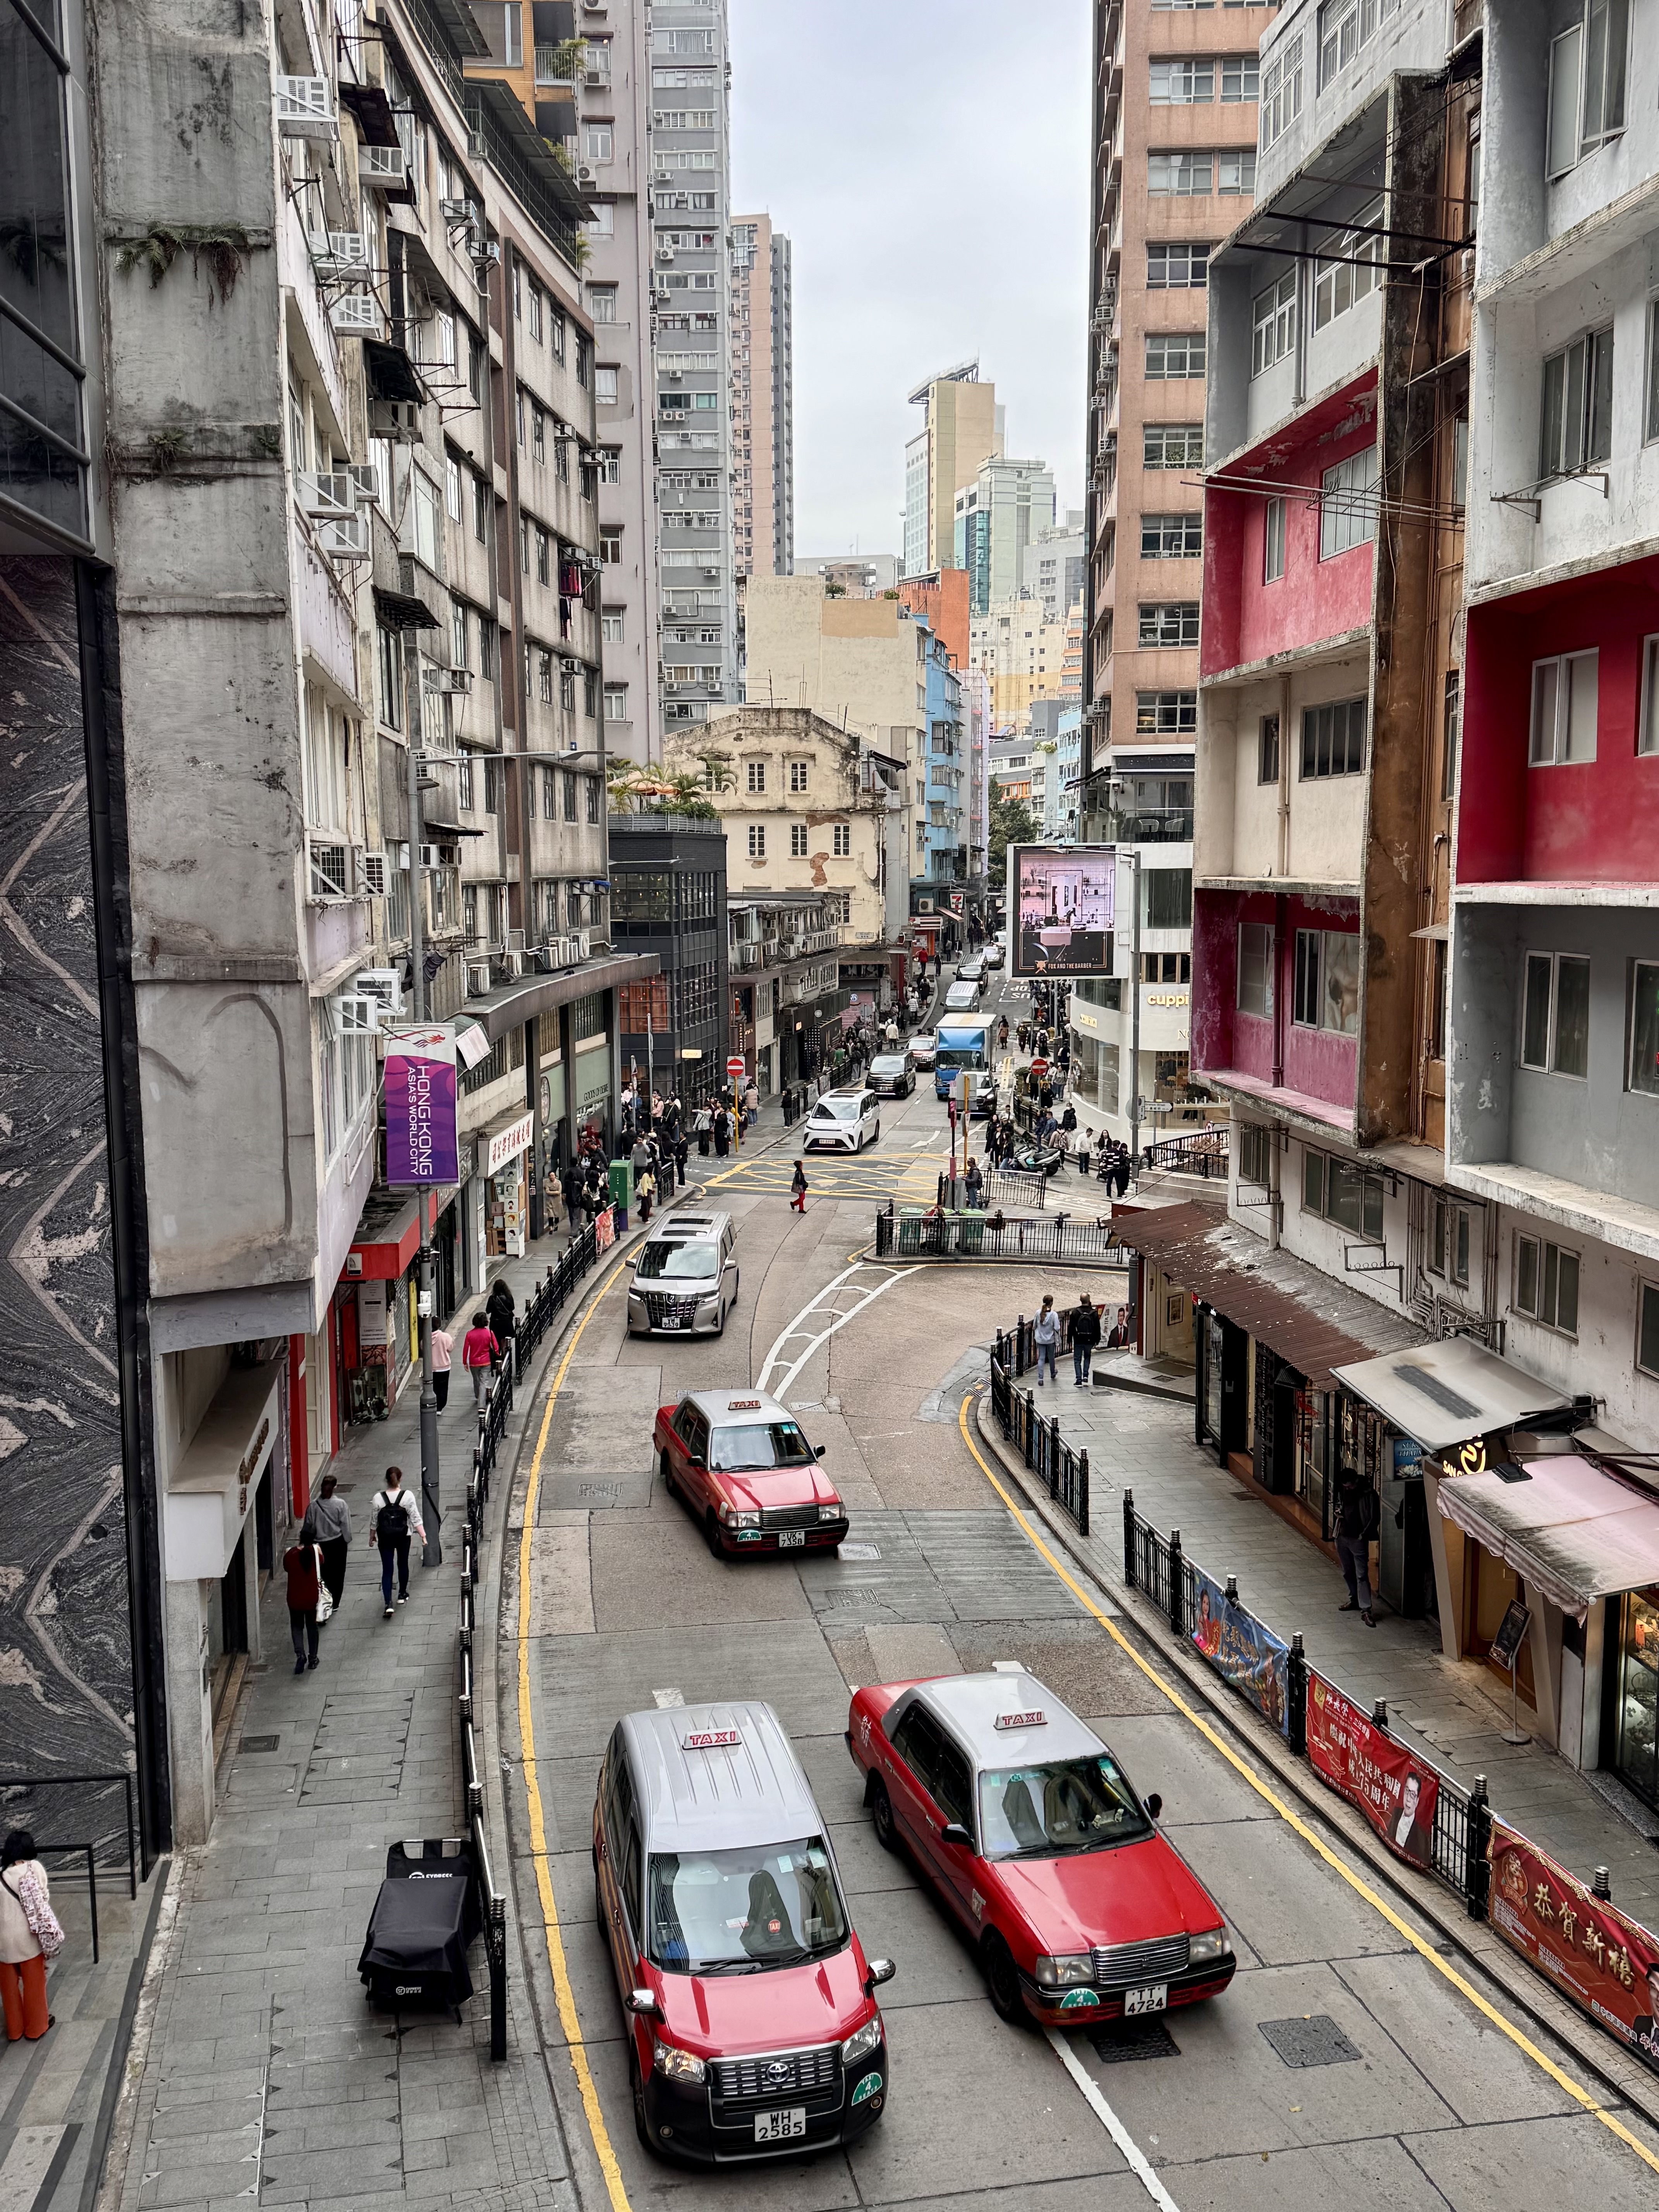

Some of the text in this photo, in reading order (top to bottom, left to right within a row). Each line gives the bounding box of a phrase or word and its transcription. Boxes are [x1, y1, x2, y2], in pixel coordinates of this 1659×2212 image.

[408, 1066, 419, 1175] ASIA'S WORLD CITY
[417, 1066, 432, 1175] HONG KONG
[1002, 1712, 1042, 1726] TAXI
[689, 1731, 736, 1745] TAXI
[1137, 1987, 1156, 2001] TT
[1127, 1997, 1163, 2013] 4724
[860, 2075, 874, 2085] TAXI
[865, 2081, 871, 2091] 4
[859, 2085, 878, 2100] SEATS
[770, 2111, 791, 2126] WH
[758, 2121, 803, 2140] 2585
